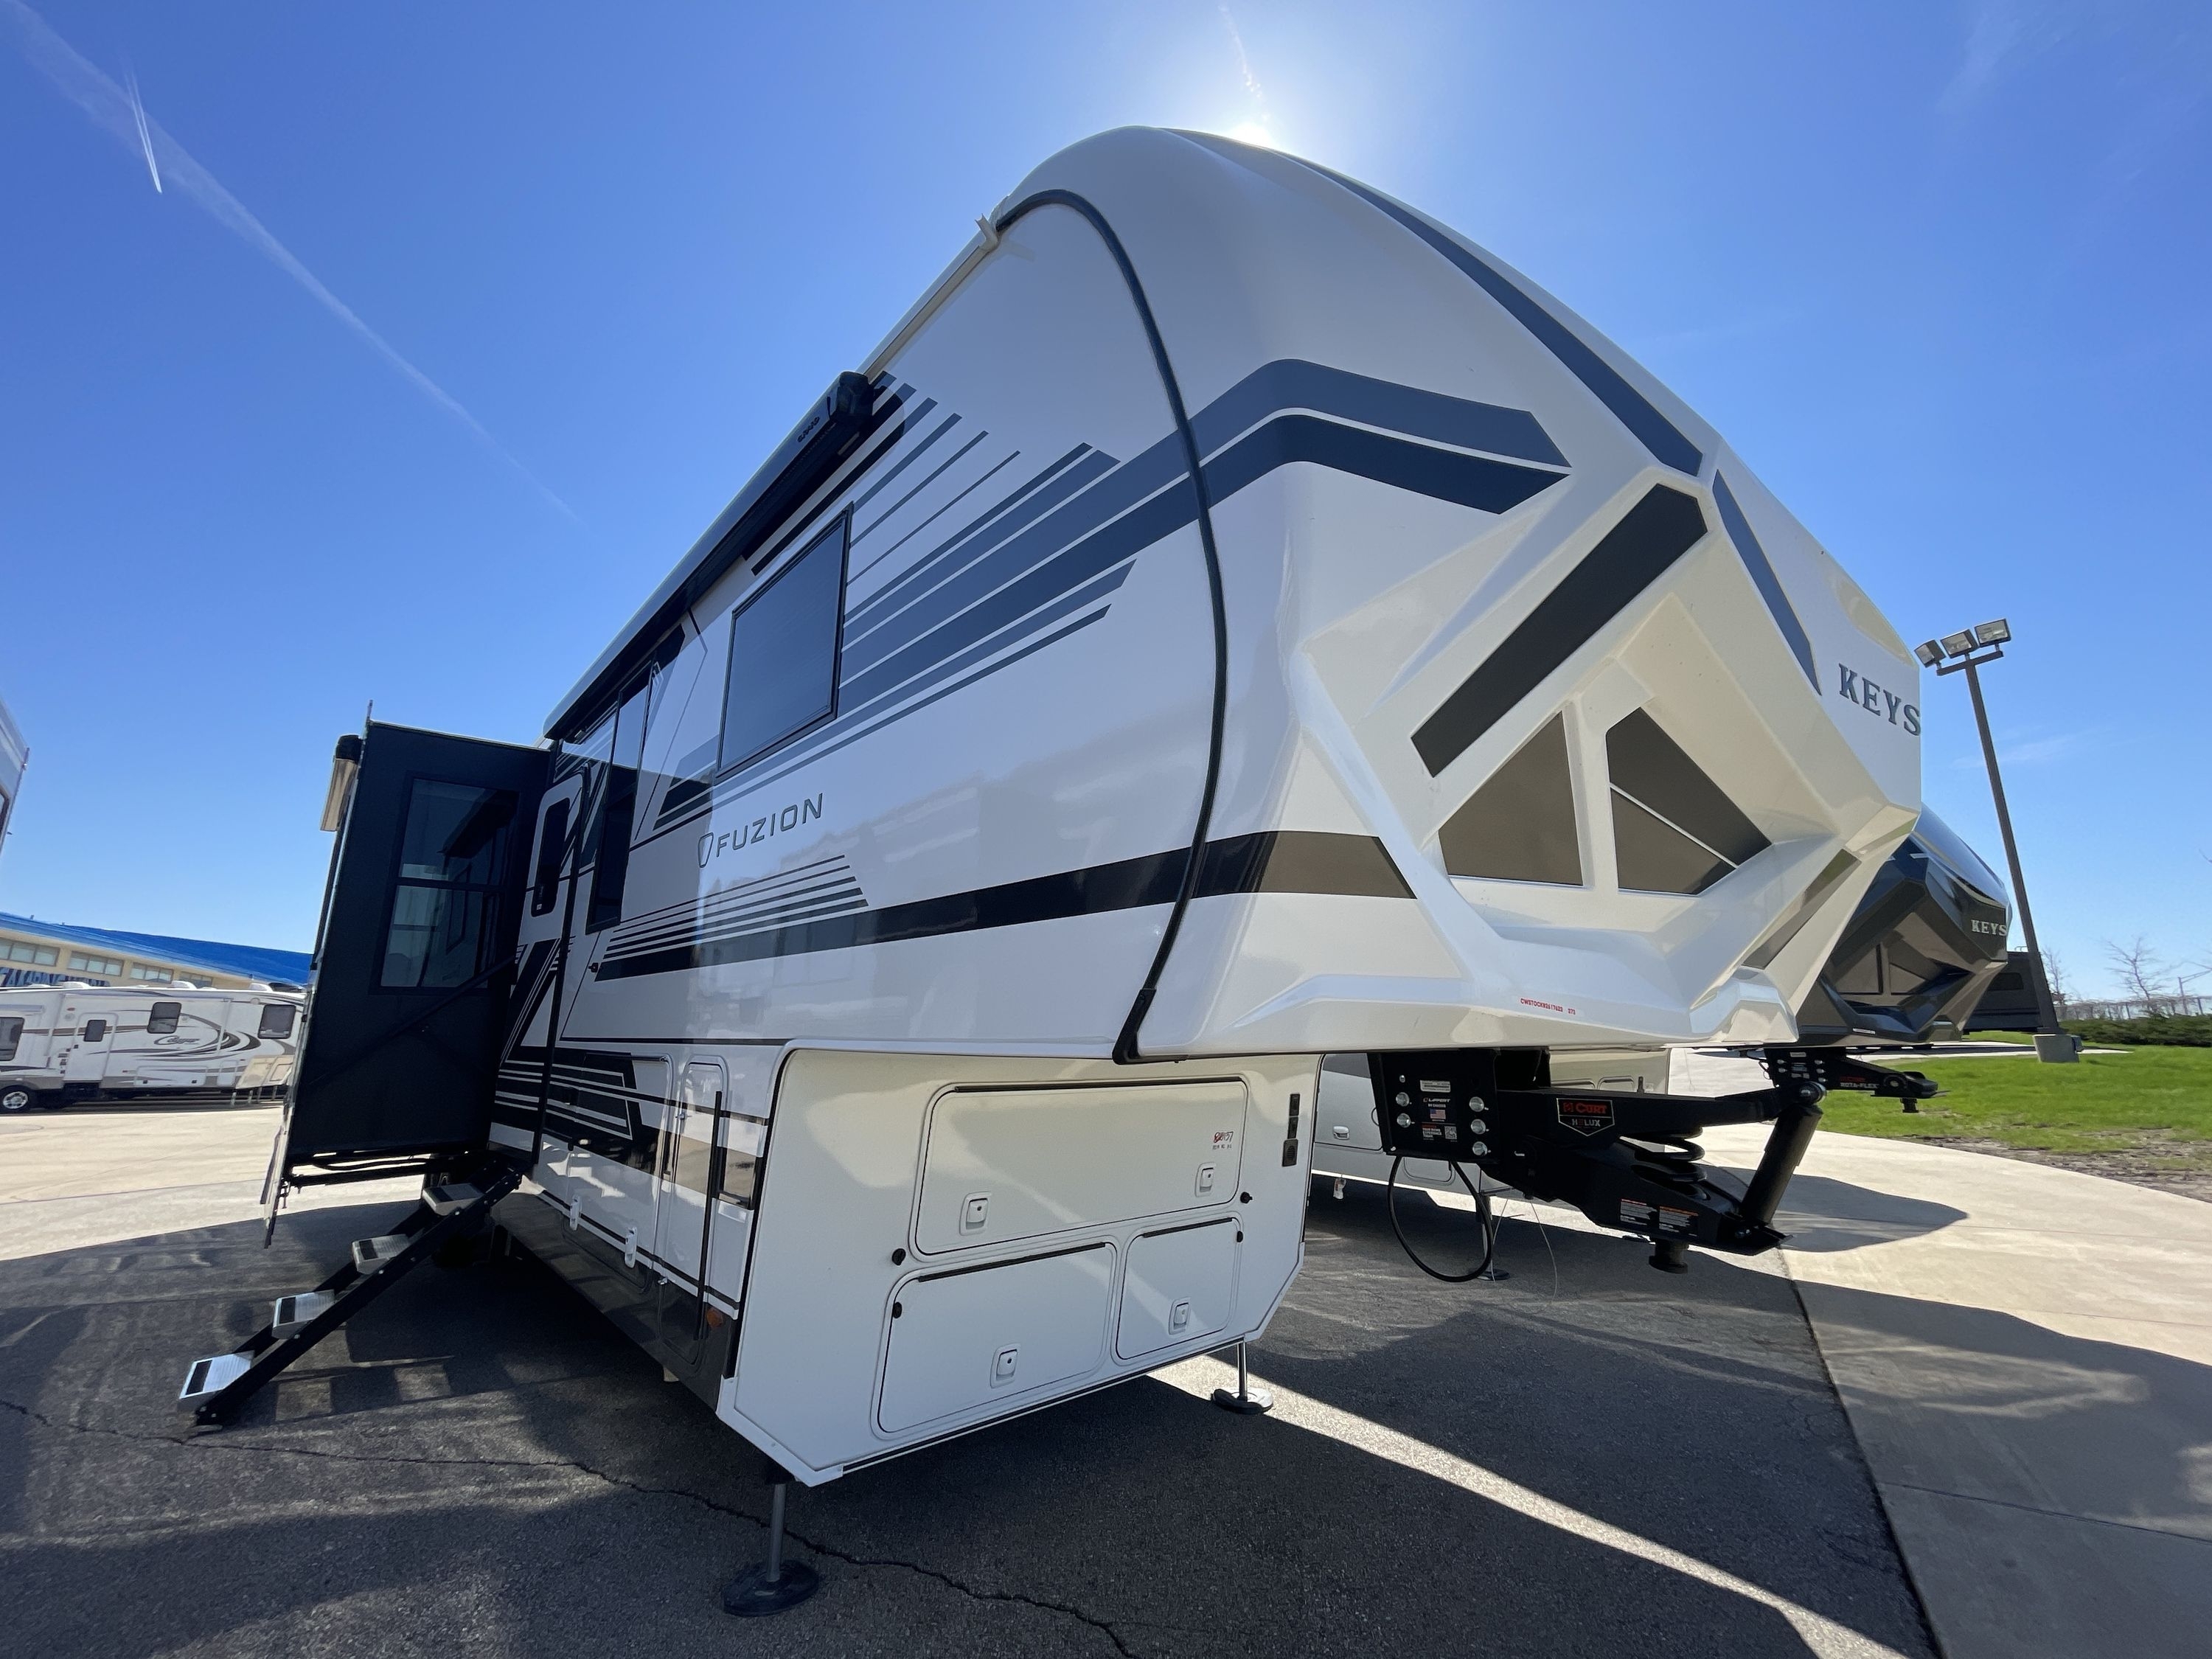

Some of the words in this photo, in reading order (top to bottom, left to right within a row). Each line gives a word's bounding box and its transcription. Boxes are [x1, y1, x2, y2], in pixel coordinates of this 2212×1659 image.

[1838, 663, 1921, 737] KEYS
[716, 793, 823, 858] FUZION
[1970, 919, 2007, 936] KEYS
[1576, 1102, 1607, 1114] CURT
